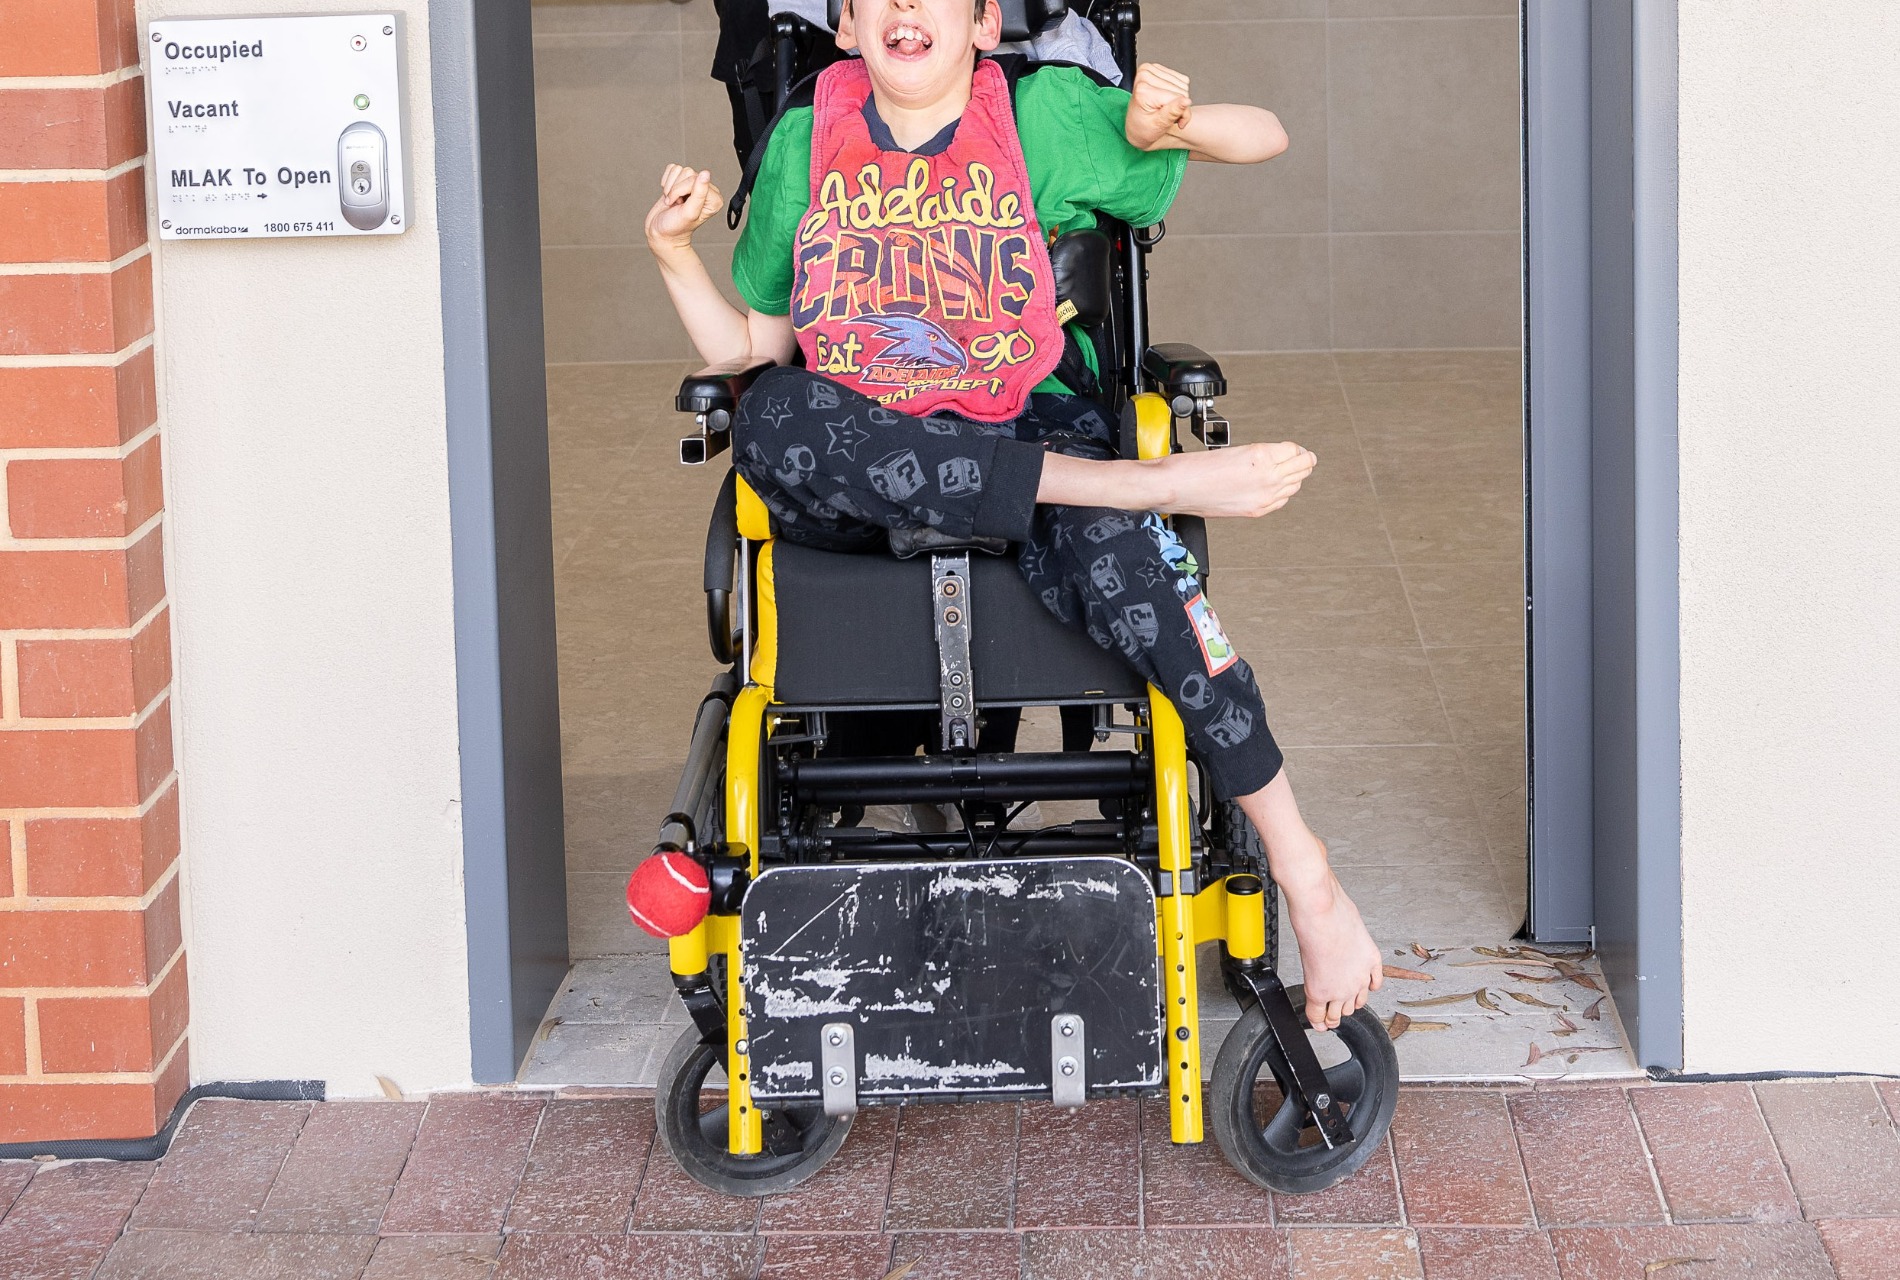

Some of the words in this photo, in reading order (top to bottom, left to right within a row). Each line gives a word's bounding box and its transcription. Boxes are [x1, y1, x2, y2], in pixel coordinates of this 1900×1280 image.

[164, 40, 264, 62] Occupied
[167, 100, 240, 118] Vacant
[171, 168, 232, 187] MLAK
[243, 167, 267, 185] To
[277, 166, 331, 188] Open
[801, 157, 1026, 243] Adelaide
[175, 225, 237, 235] dormakaba
[264, 223, 290, 232] 1800
[293, 222, 313, 232] 675
[316, 221, 335, 231] 411
[793, 225, 1037, 332] CROWS
[815, 331, 865, 375] Est
[969, 329, 1036, 373] 90
[866, 365, 961, 383] ADELAIDE
